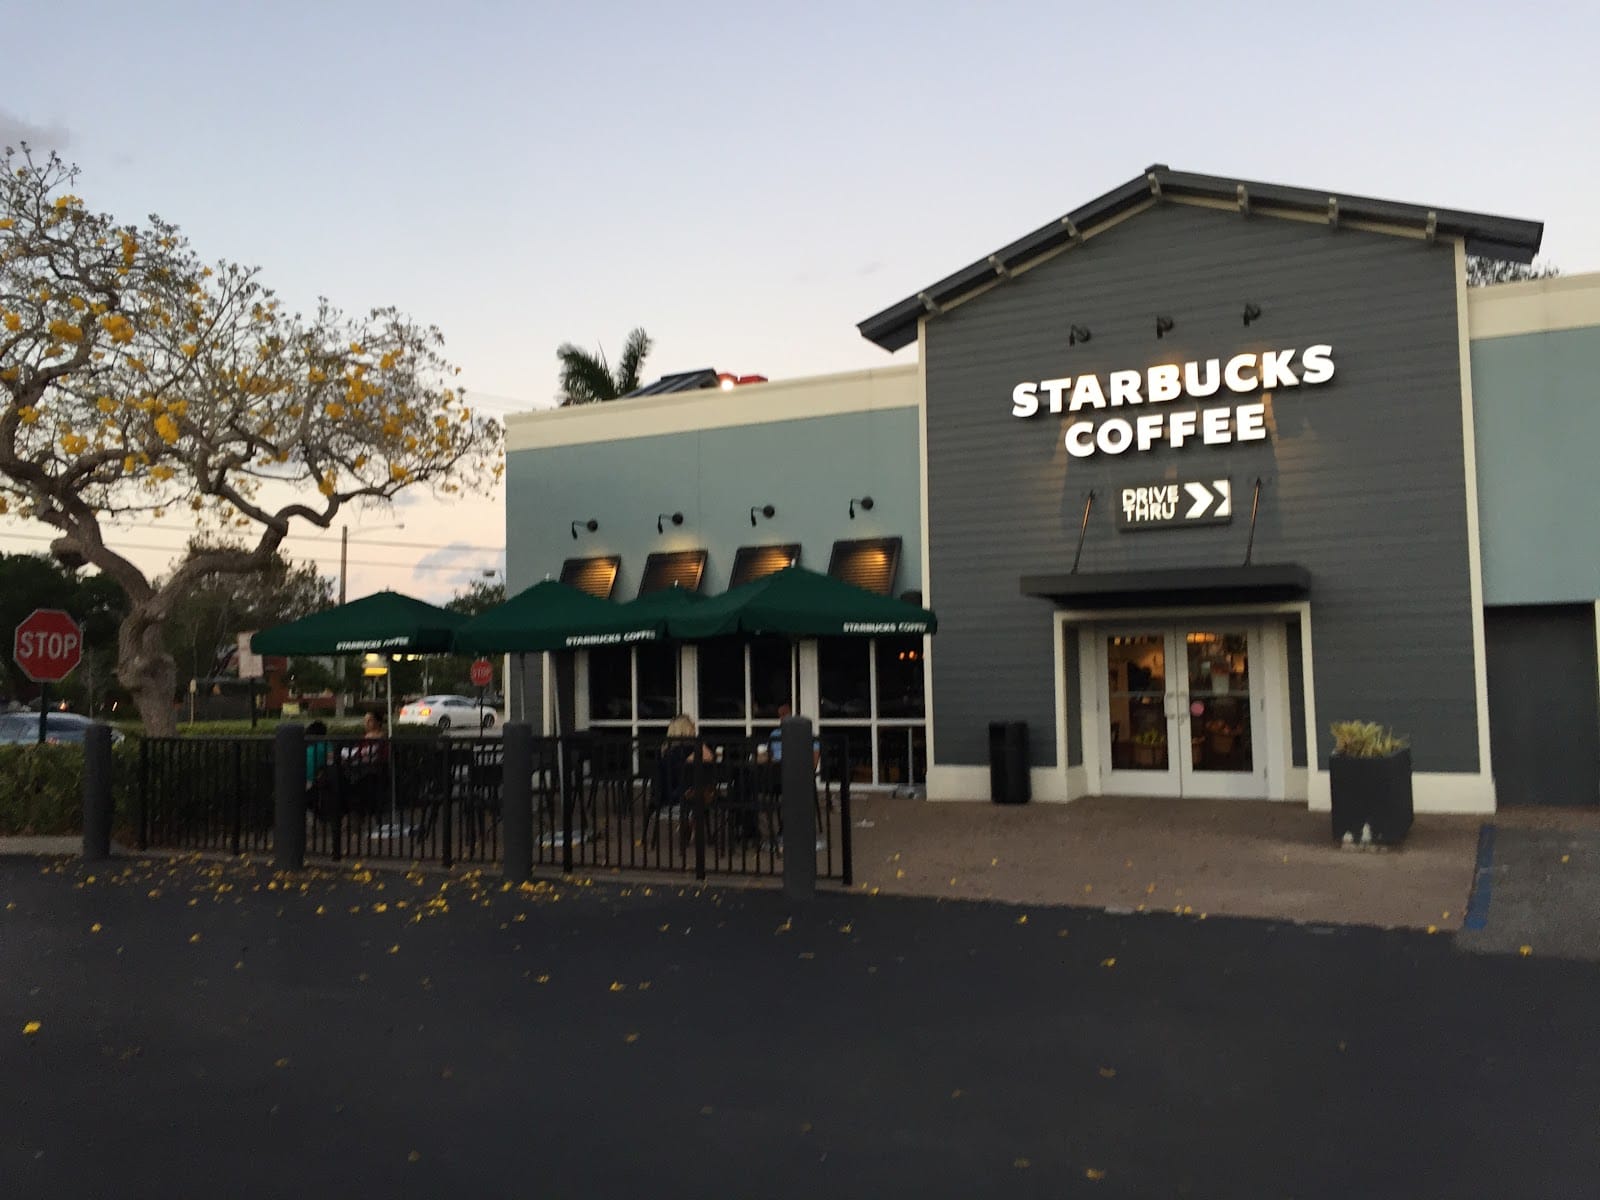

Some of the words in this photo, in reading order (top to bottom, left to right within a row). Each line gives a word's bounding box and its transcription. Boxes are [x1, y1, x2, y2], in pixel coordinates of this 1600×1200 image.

[1012, 345, 1335, 417] STARBUCKS
[1065, 404, 1266, 457] COFFEE
[1122, 485, 1179, 507] DRIVE
[1123, 502, 1176, 522] THRU
[19, 631, 78, 660] STOP
